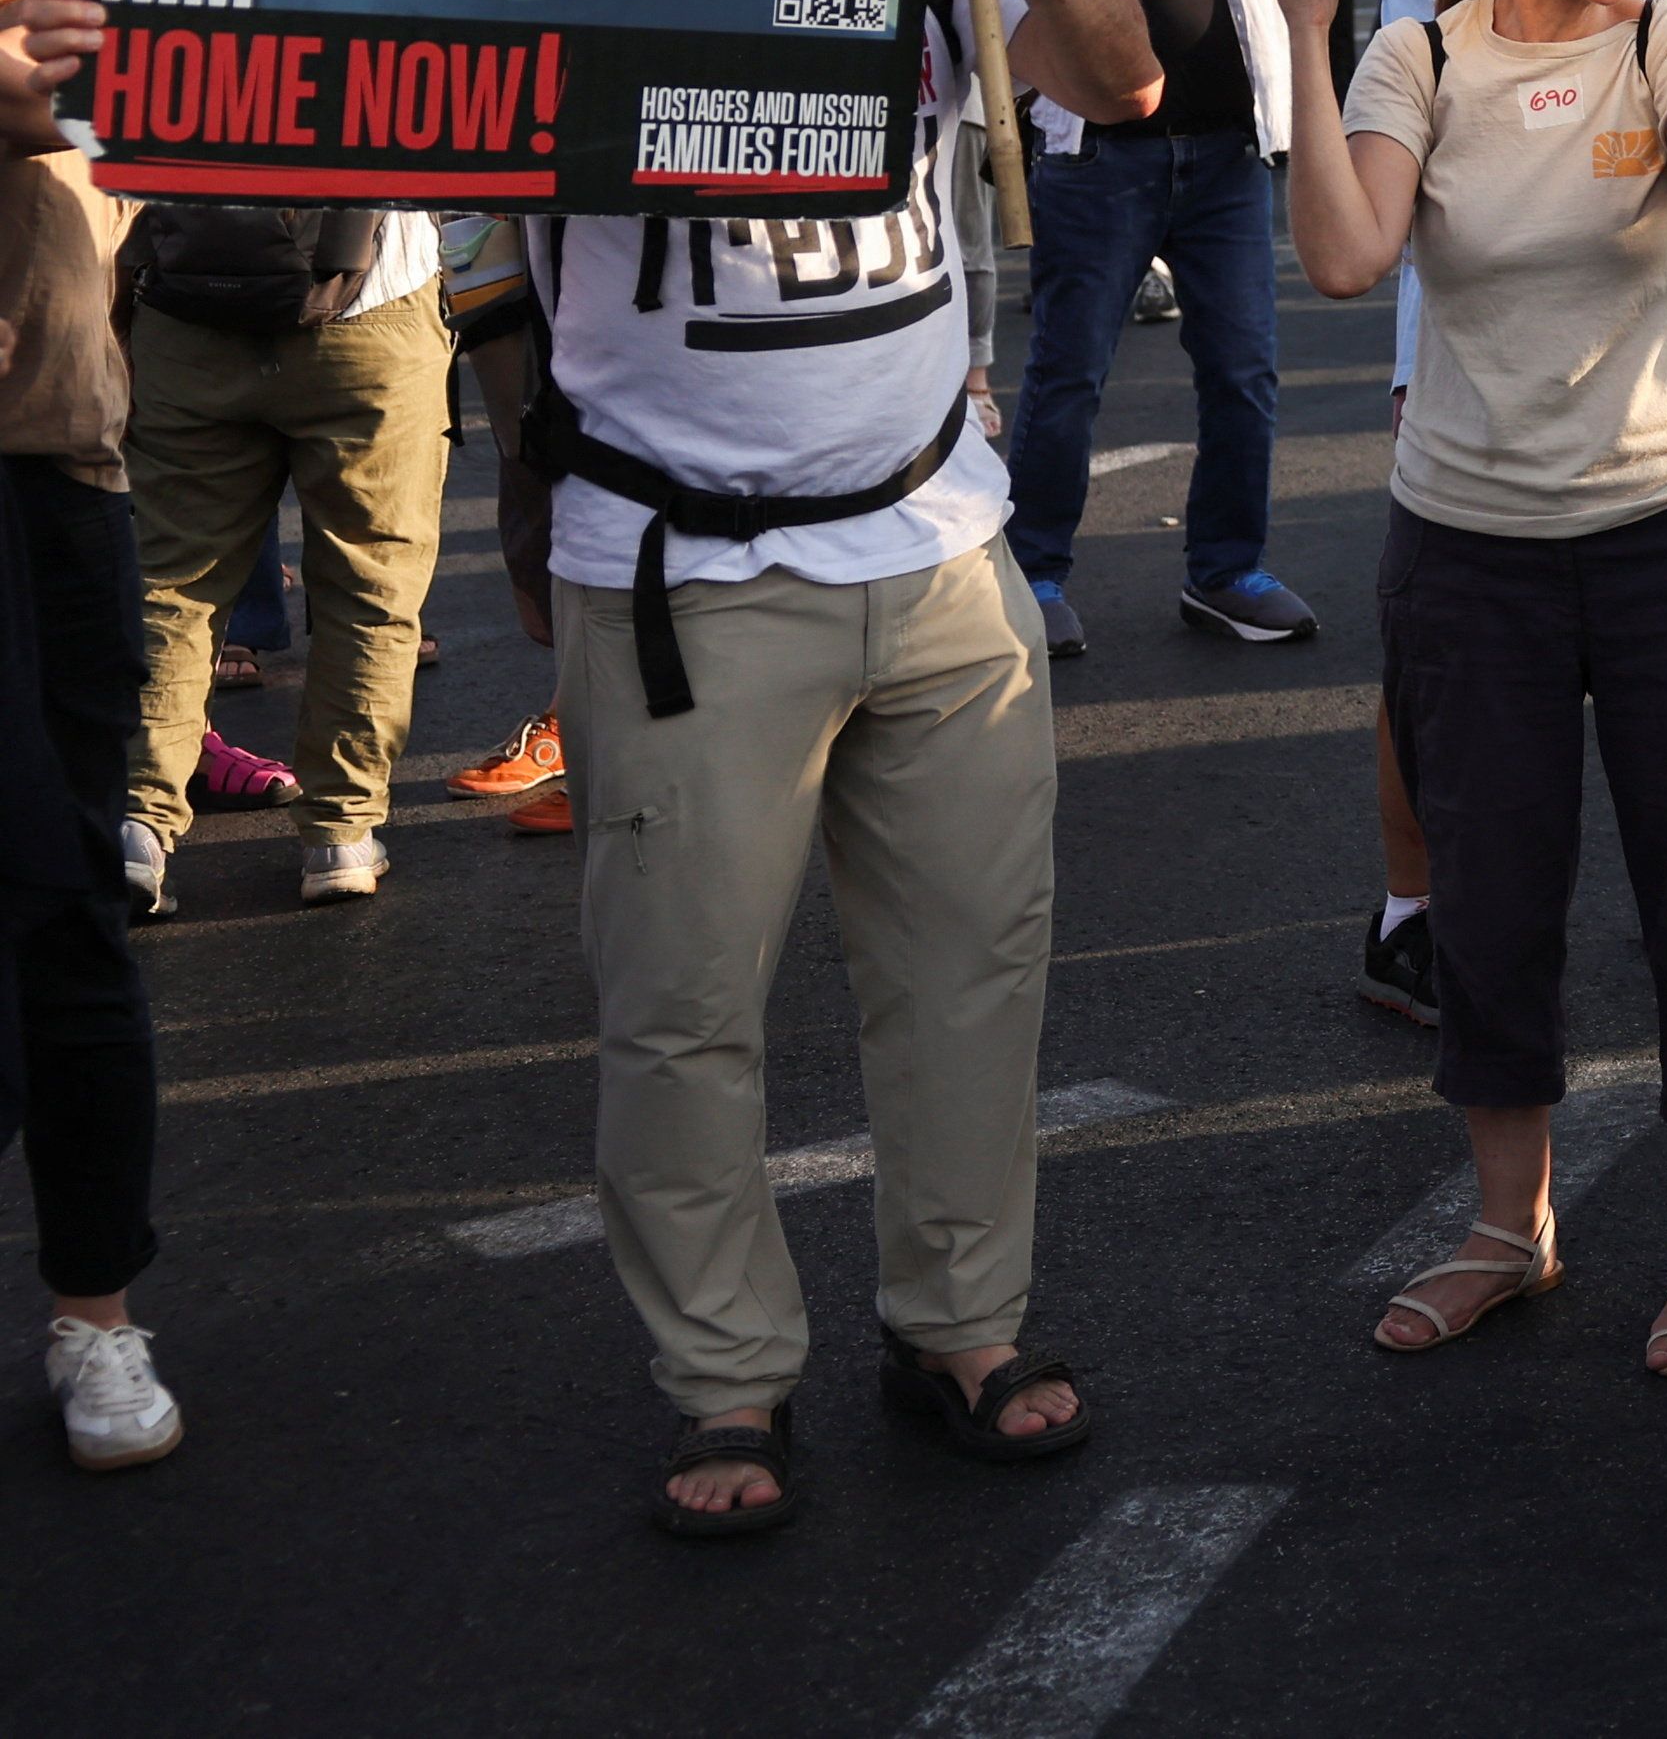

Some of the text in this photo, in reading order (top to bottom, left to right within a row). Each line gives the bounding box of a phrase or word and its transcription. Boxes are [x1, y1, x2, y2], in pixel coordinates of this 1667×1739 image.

[92, 28, 562, 155] HOME NOW!
[641, 86, 888, 128] HOSTAGES AND MISSING
[1529, 88, 1578, 111] 690
[637, 122, 886, 178] FAMILIES FORUM
